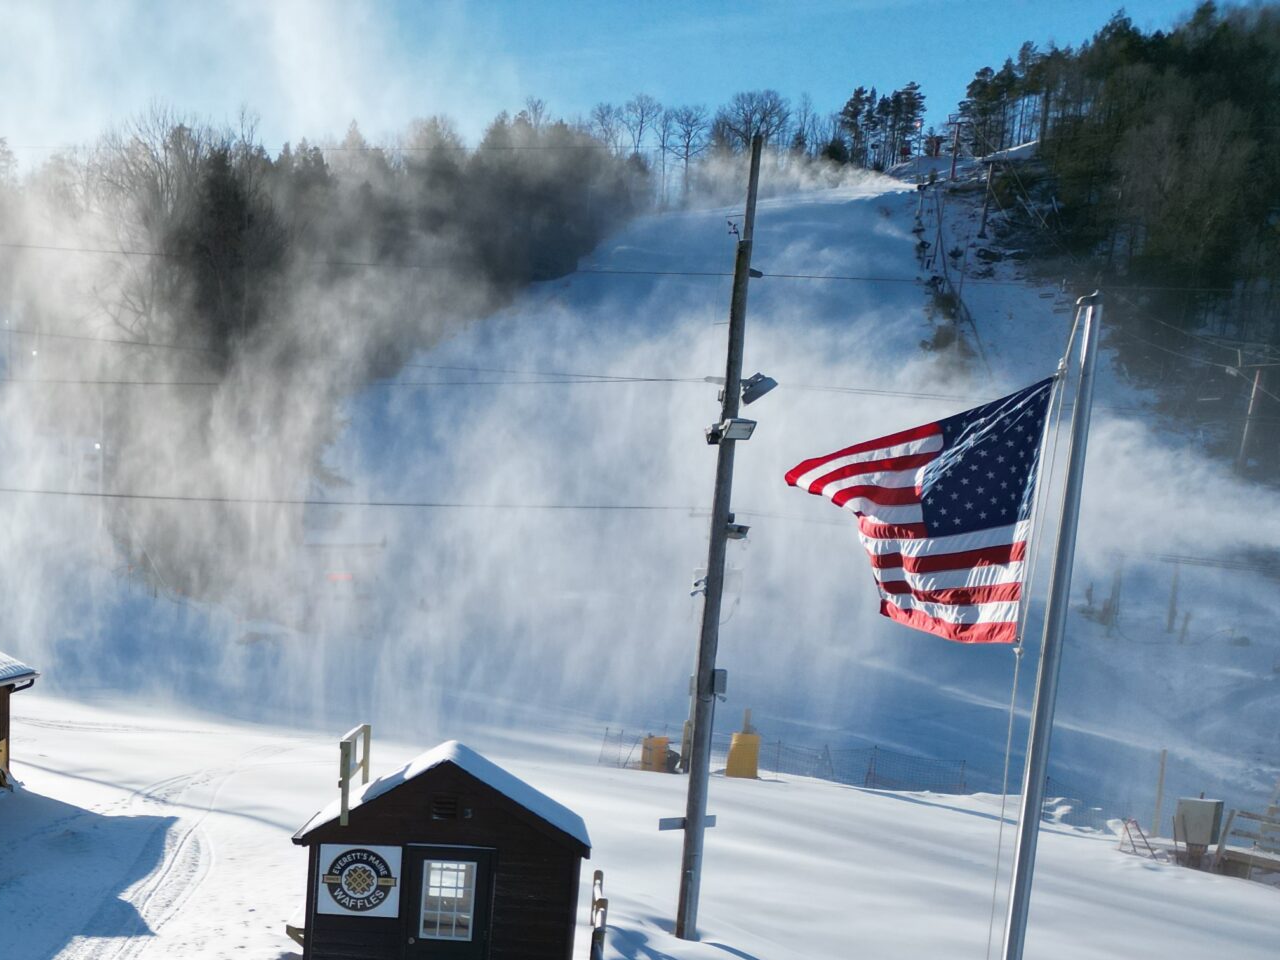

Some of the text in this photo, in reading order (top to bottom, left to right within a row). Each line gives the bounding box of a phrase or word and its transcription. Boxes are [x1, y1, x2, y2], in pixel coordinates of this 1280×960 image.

[332, 852, 388, 877] EVERETT'S MAINE
[334, 888, 385, 909] WAFFLES
